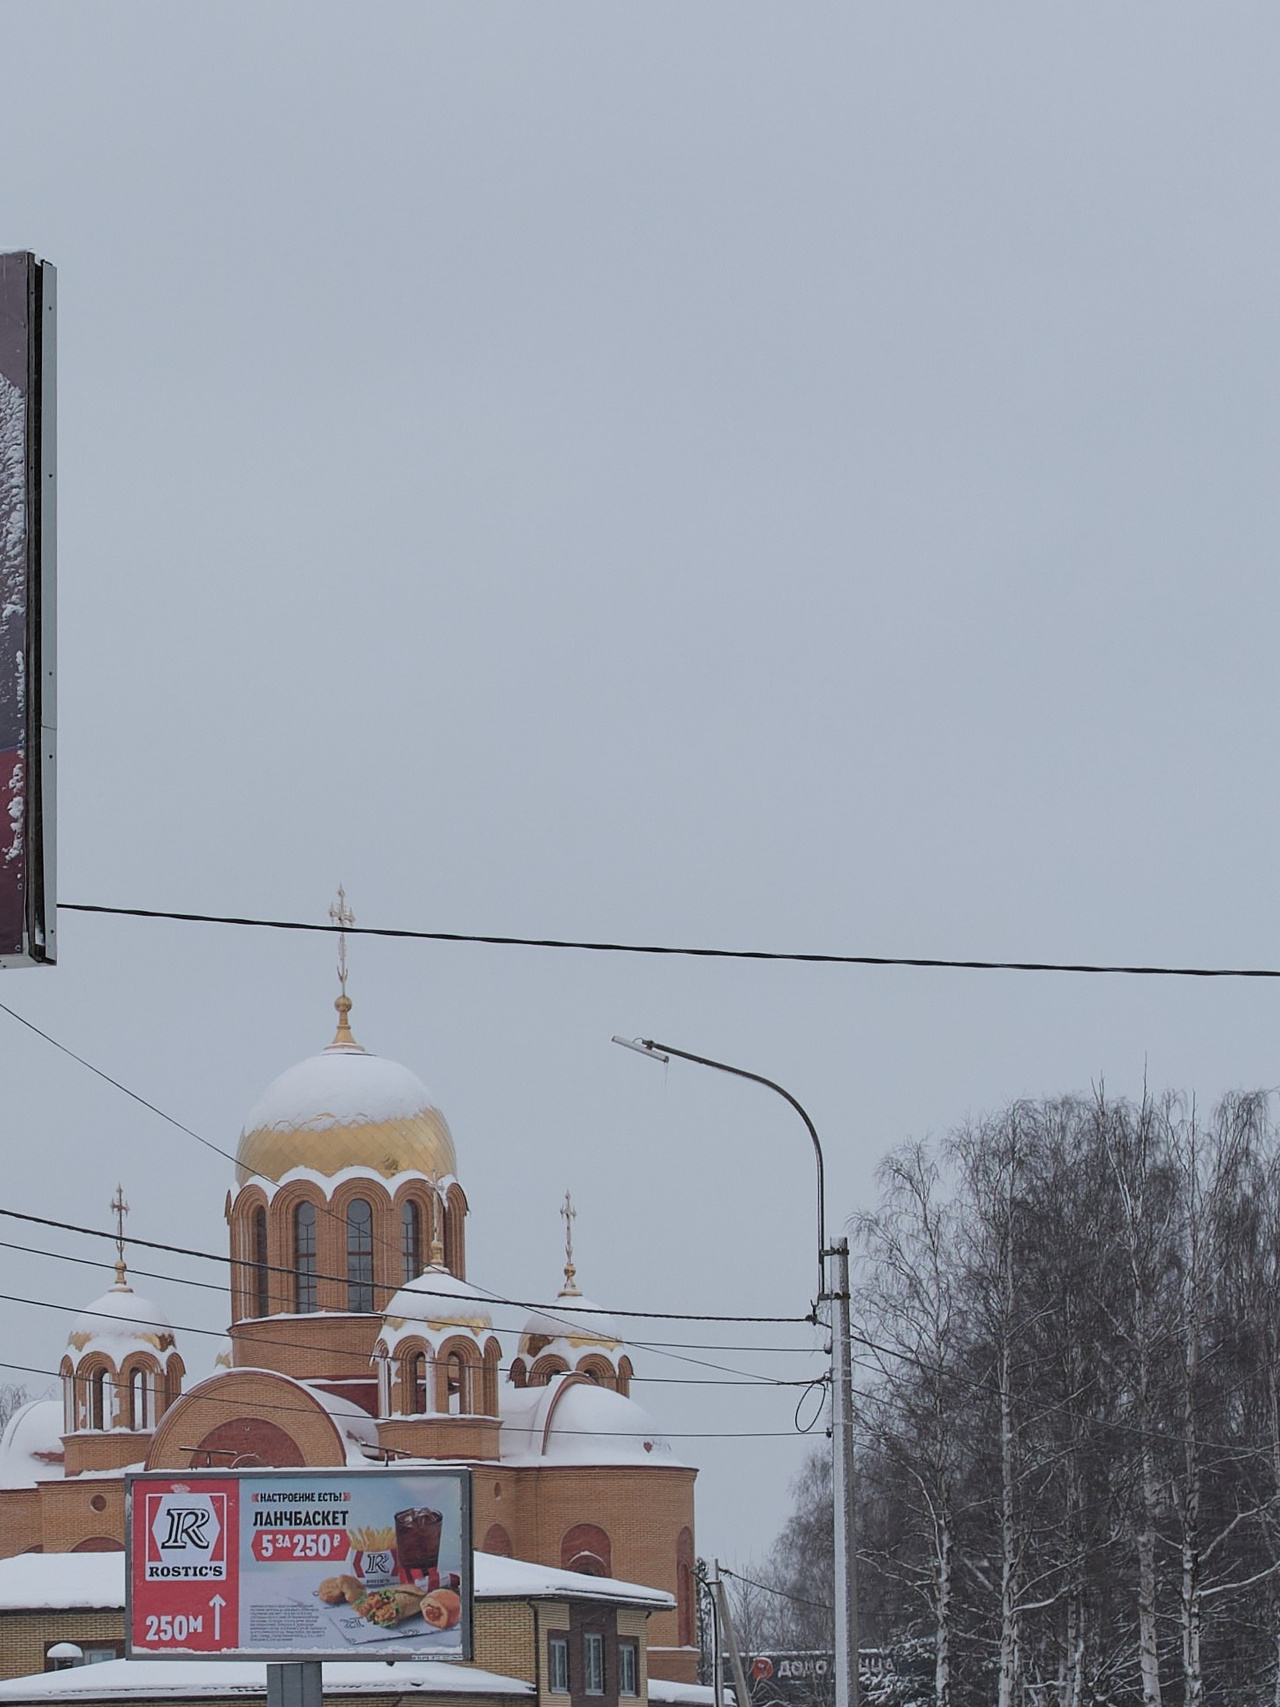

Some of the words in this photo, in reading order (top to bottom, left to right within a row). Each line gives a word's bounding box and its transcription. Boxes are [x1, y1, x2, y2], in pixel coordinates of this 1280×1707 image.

[260, 1492, 316, 1503] НАСТРОЕНИЕ
[318, 1492, 342, 1502] ЕСТЬ!
[252, 1510, 349, 1526] ЛАНЧБАСКЕТ
[261, 1534, 274, 1558] 5
[148, 1566, 223, 1578] ROSTIC'S
